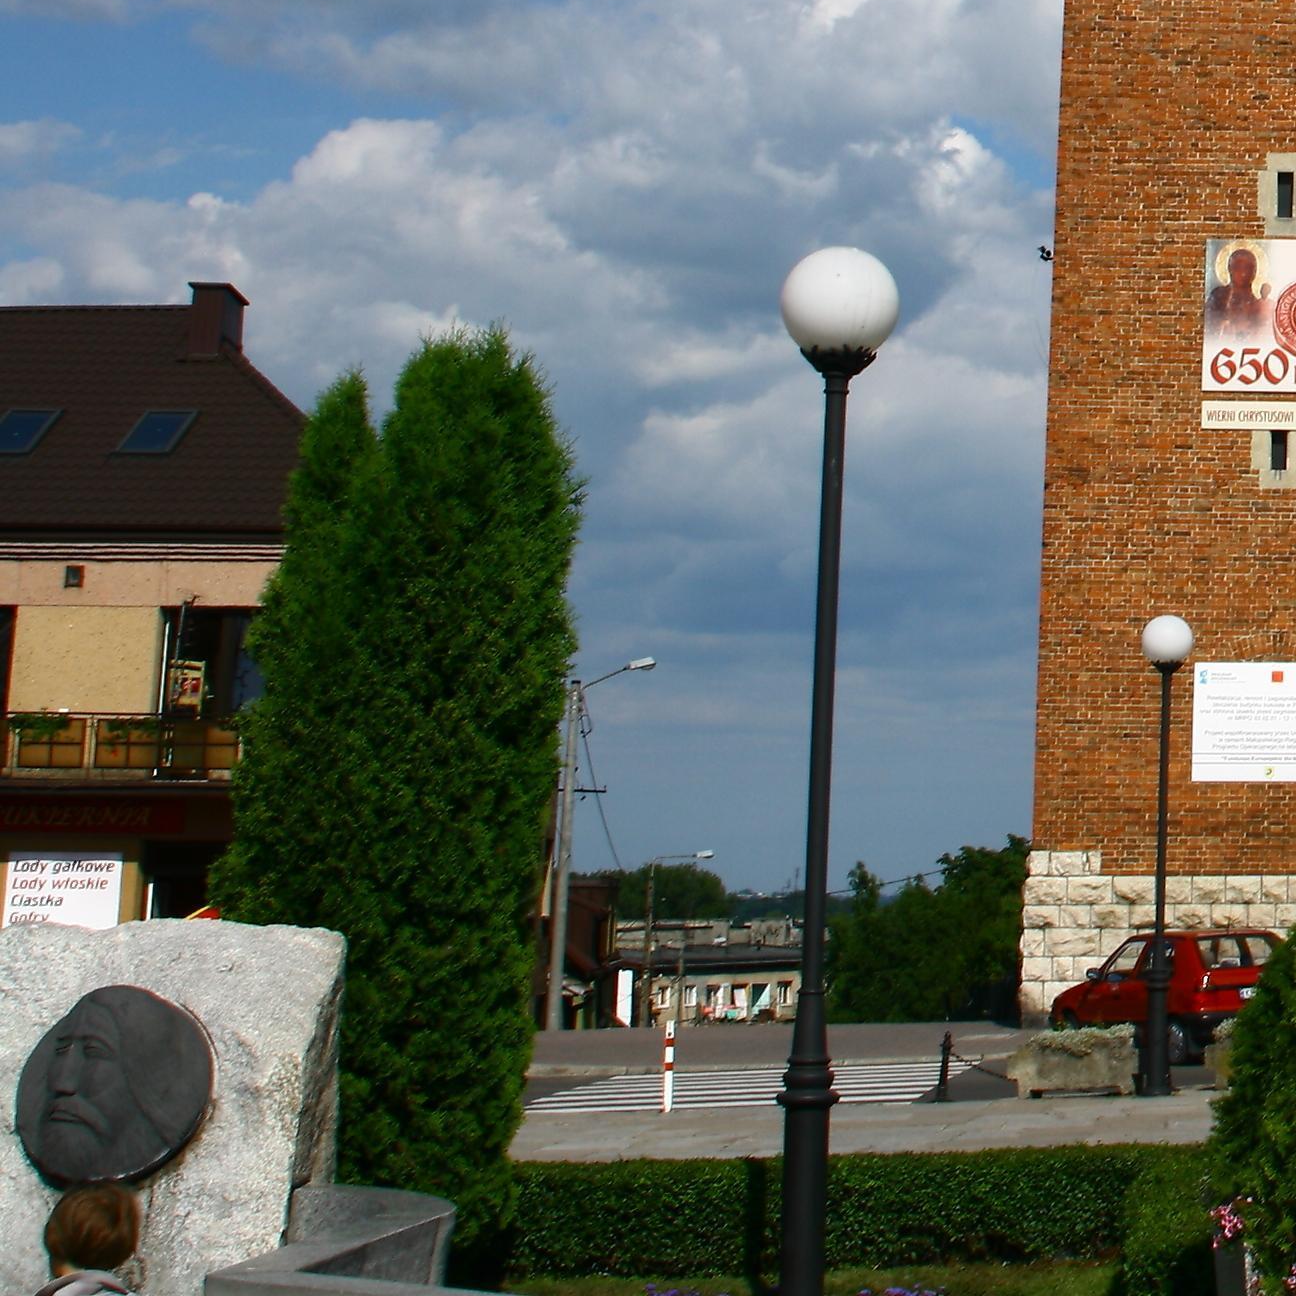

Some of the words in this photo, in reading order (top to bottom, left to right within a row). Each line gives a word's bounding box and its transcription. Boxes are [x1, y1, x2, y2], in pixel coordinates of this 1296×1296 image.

[1210, 347, 1290, 385] 650
[1206, 409, 1236, 423] WIERNI
[1237, 409, 1294, 424] CHRYSTUSOWI
[0, 806, 151, 825] UKIERNIA
[12, 859, 48, 874] Lody
[51, 860, 116, 875] gałkowe
[11, 877, 48, 891] Lody
[51, 877, 109, 889] włoskie
[10, 894, 64, 907] Ciastka
[9, 911, 51, 924] Gofry
